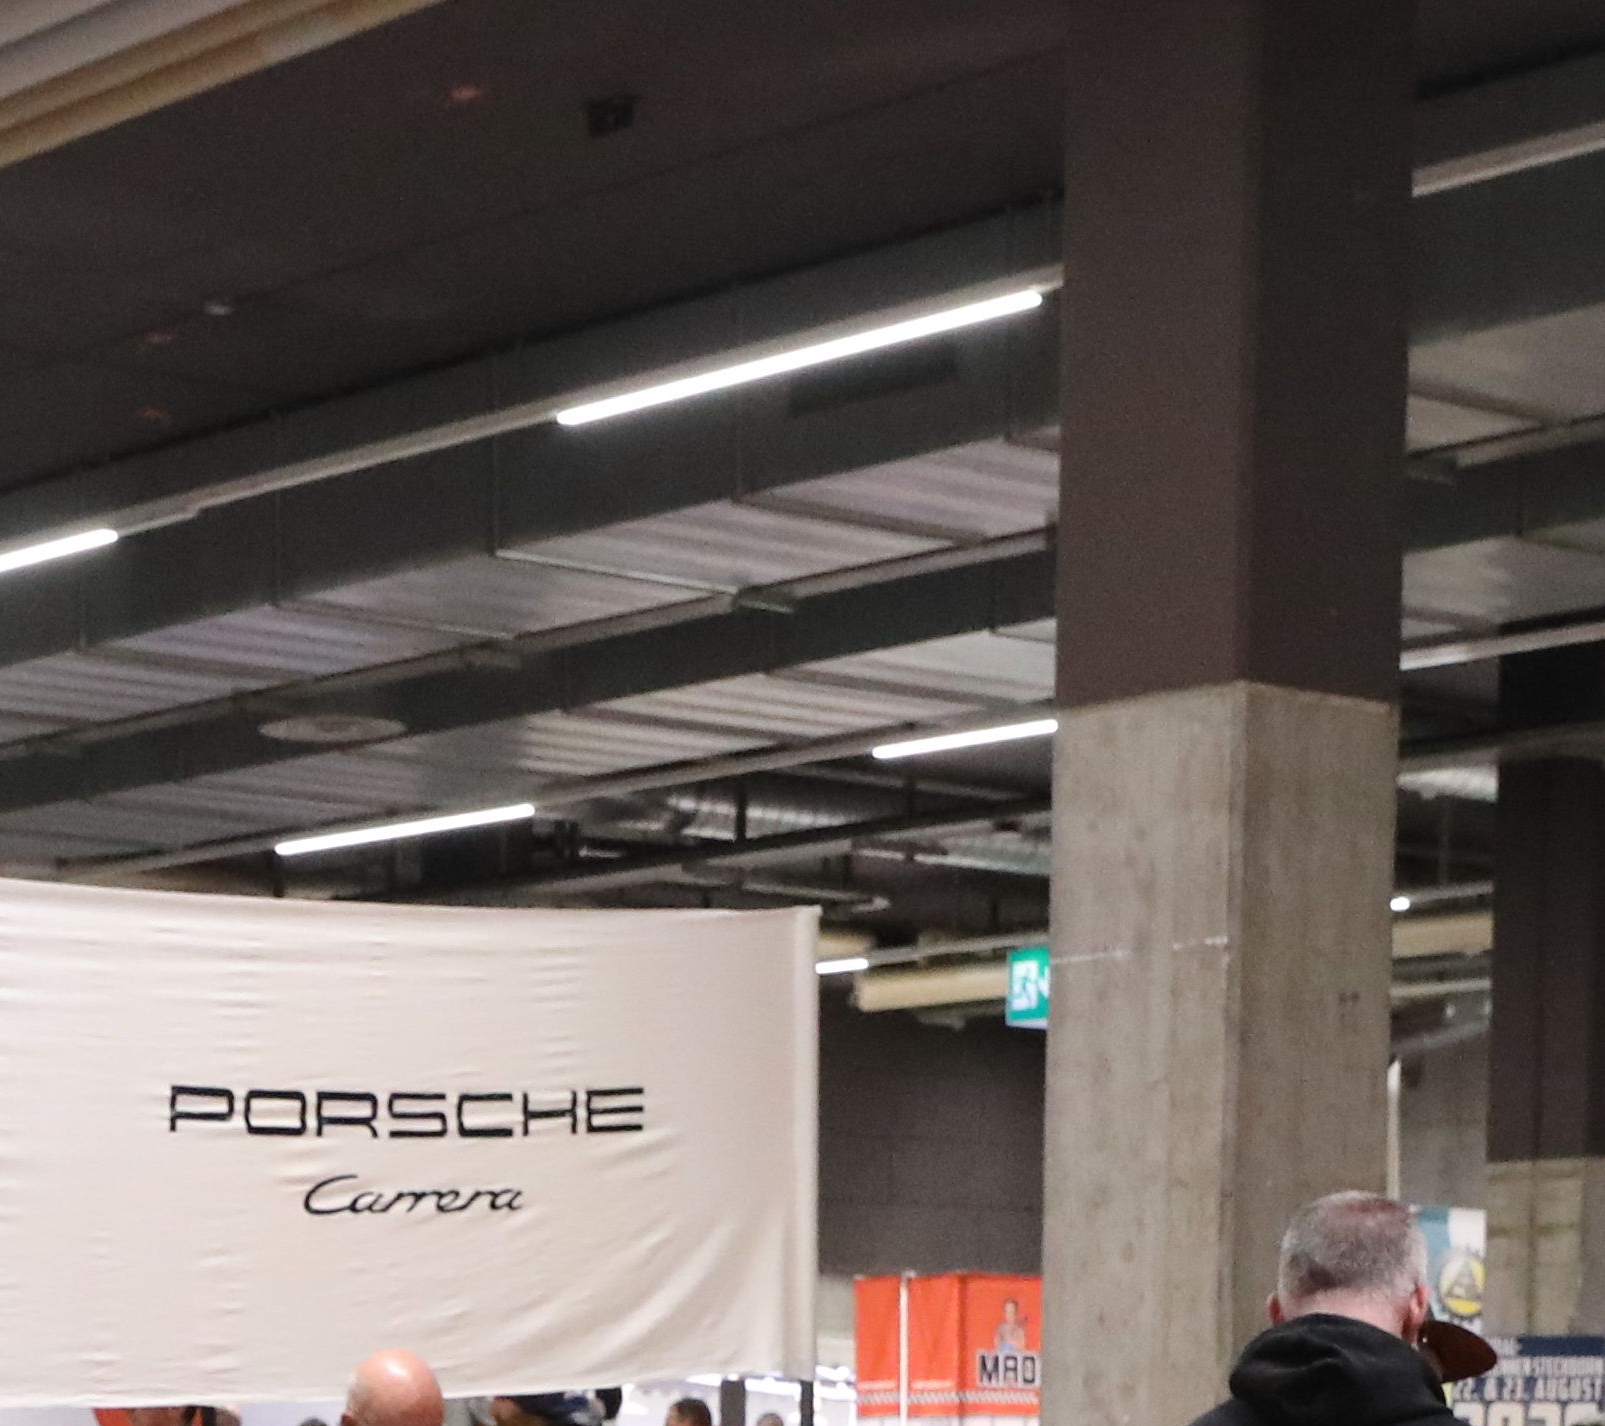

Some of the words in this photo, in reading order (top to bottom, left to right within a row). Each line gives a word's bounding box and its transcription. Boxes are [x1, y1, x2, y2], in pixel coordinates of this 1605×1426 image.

[169, 1084, 645, 1139] PORSCHE
[303, 1173, 525, 1216] Carrera
[1534, 1376, 1603, 1400] AUGUST
